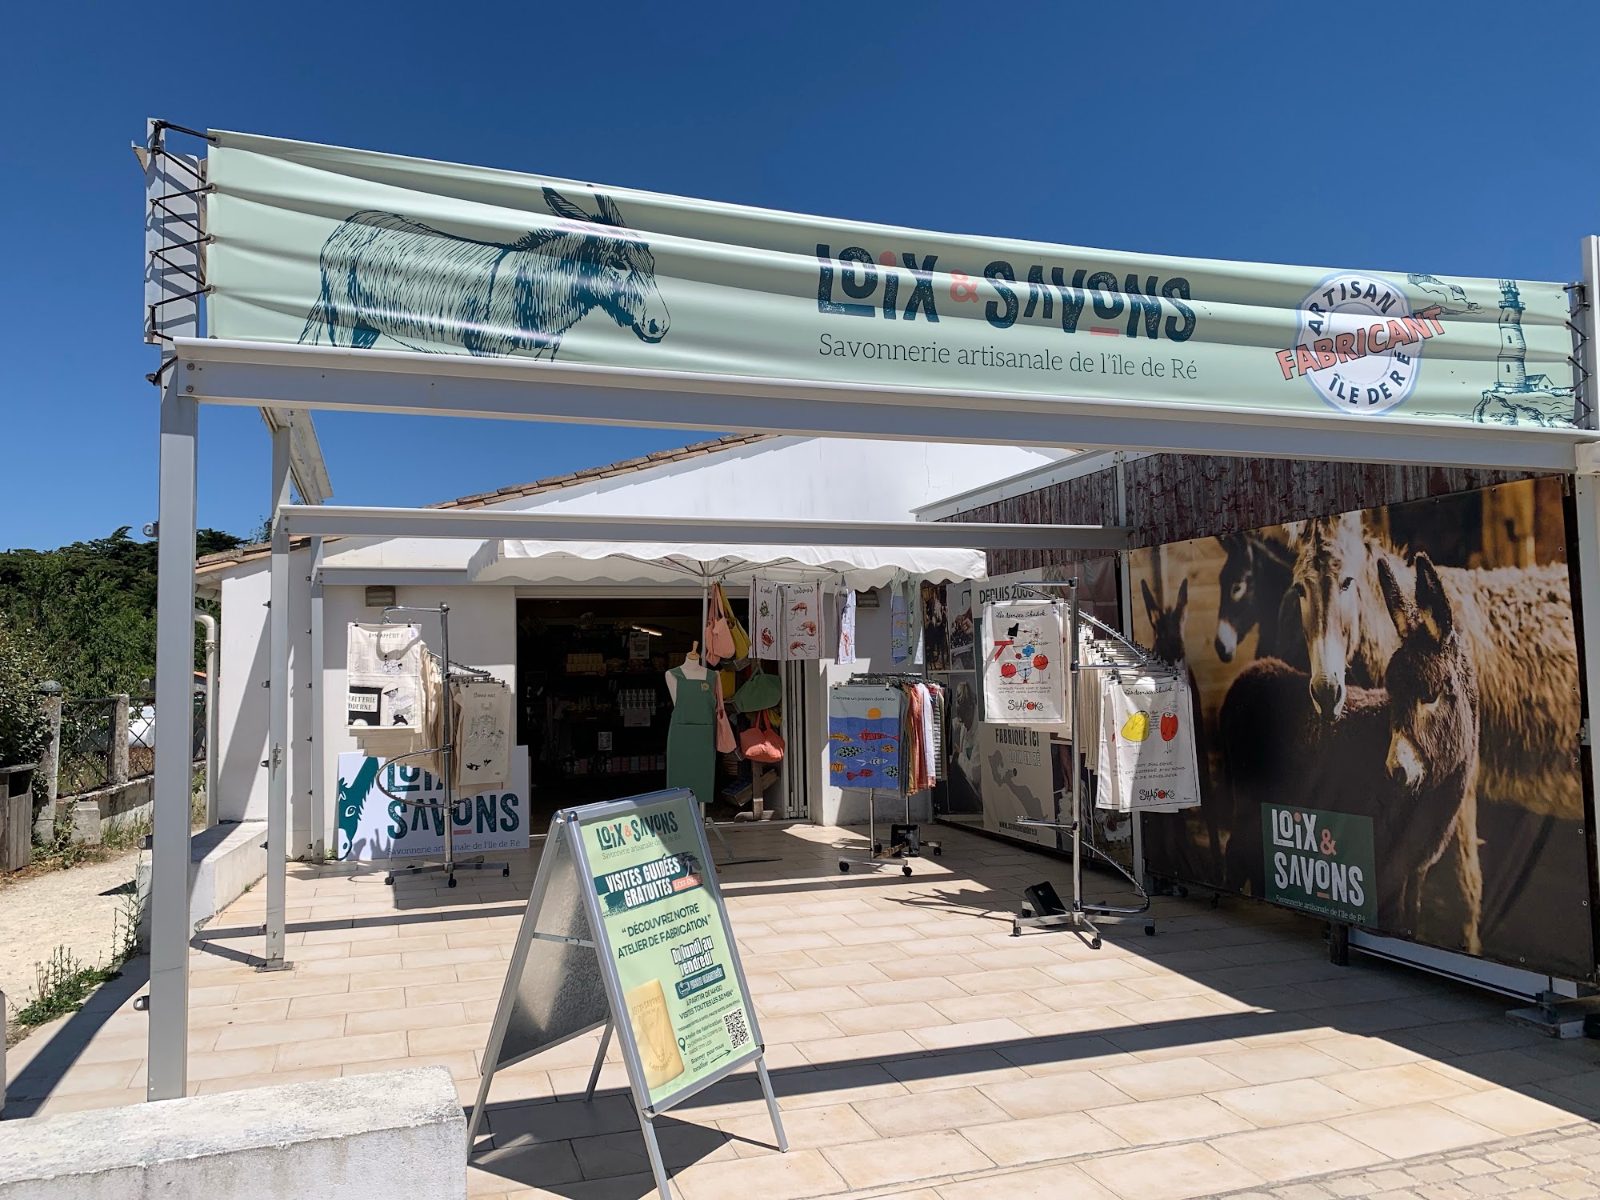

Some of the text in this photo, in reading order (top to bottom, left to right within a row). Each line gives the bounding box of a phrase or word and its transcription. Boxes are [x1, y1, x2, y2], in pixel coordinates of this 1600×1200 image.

[950, 268, 979, 304] &
[983, 260, 1197, 343] SAVONS
[1308, 280, 1397, 336] ARTISAN
[818, 333, 951, 365] Savonnerie
[957, 345, 1064, 372] artisanale
[1069, 350, 1094, 375] de
[1141, 356, 1166, 379] de
[1172, 359, 1198, 381] Ré
[1275, 307, 1445, 381] FABRICANT
[1328, 348, 1412, 407] ÎLE DE RÉ
[979, 586, 1010, 605] DEPUIS
[995, 727, 1027, 746] FABRIQUÉ
[387, 793, 520, 840] SAVONS
[630, 811, 678, 842] SAVONS
[1320, 828, 1337, 856] &
[605, 867, 643, 894] VISITES
[642, 853, 681, 884] GUIDÉES
[623, 878, 673, 909] GRATUITES
[1274, 851, 1365, 907] SAVONS
[674, 902, 700, 922] NOTRE
[618, 937, 649, 959] ATELIER
[649, 934, 660, 947] DE
